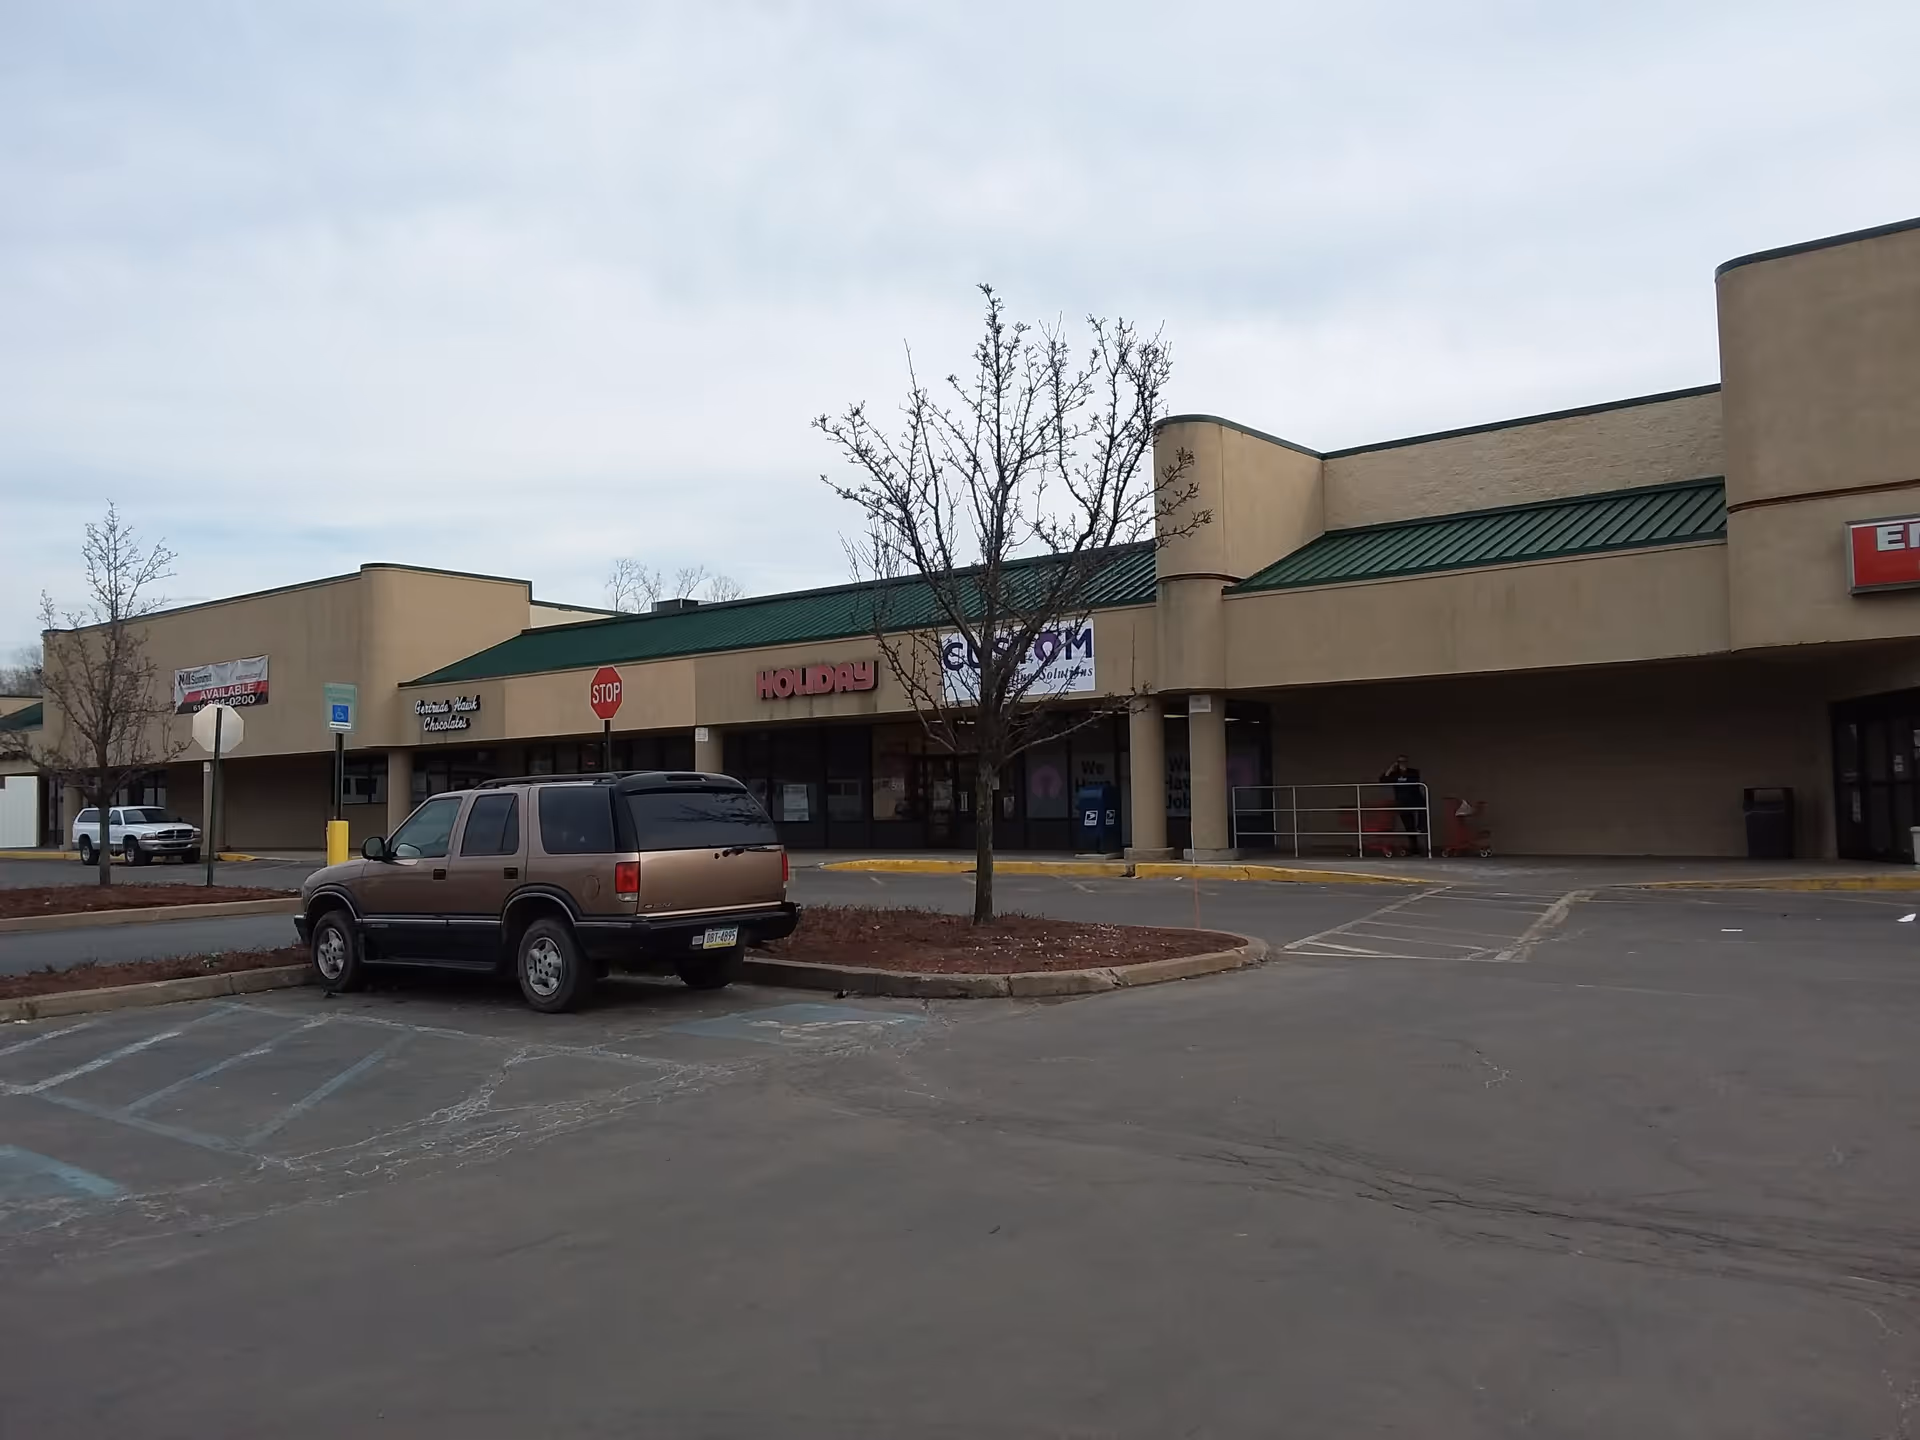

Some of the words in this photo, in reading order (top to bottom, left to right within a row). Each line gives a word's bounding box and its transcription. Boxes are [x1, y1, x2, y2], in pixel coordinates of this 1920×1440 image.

[756, 660, 878, 698] HOLIDAY
[200, 683, 255, 700] AVAILABLE
[592, 682, 621, 704] STOP
[414, 699, 451, 715] Gertrude
[453, 694, 480, 711] Hawk
[423, 714, 469, 731] Chocolates
